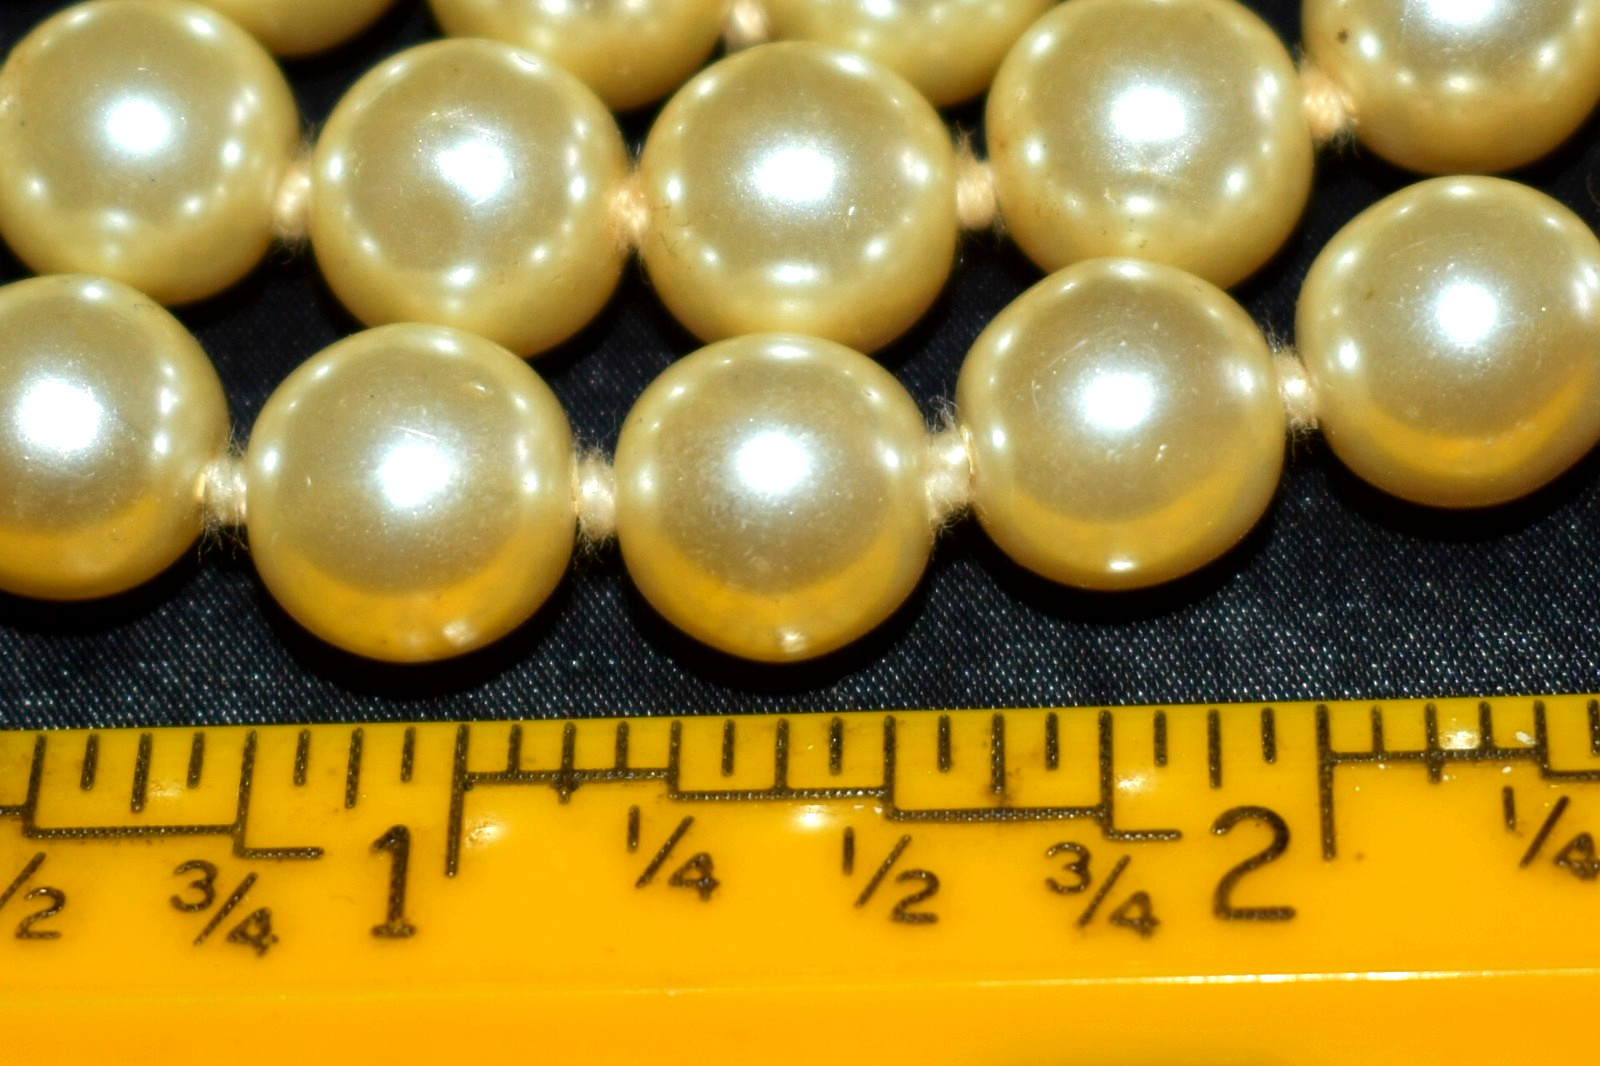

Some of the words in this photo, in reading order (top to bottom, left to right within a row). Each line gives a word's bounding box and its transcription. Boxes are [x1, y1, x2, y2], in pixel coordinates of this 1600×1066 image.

[368, 823, 418, 940] 1
[626, 804, 721, 902] 1/4
[842, 826, 941, 925] 1/2
[1209, 805, 1297, 921] 2
[1502, 785, 1600, 881] 1/4
[0, 851, 67, 940] /2
[169, 858, 280, 958] 3/4
[1044, 841, 1161, 939] 3/4
